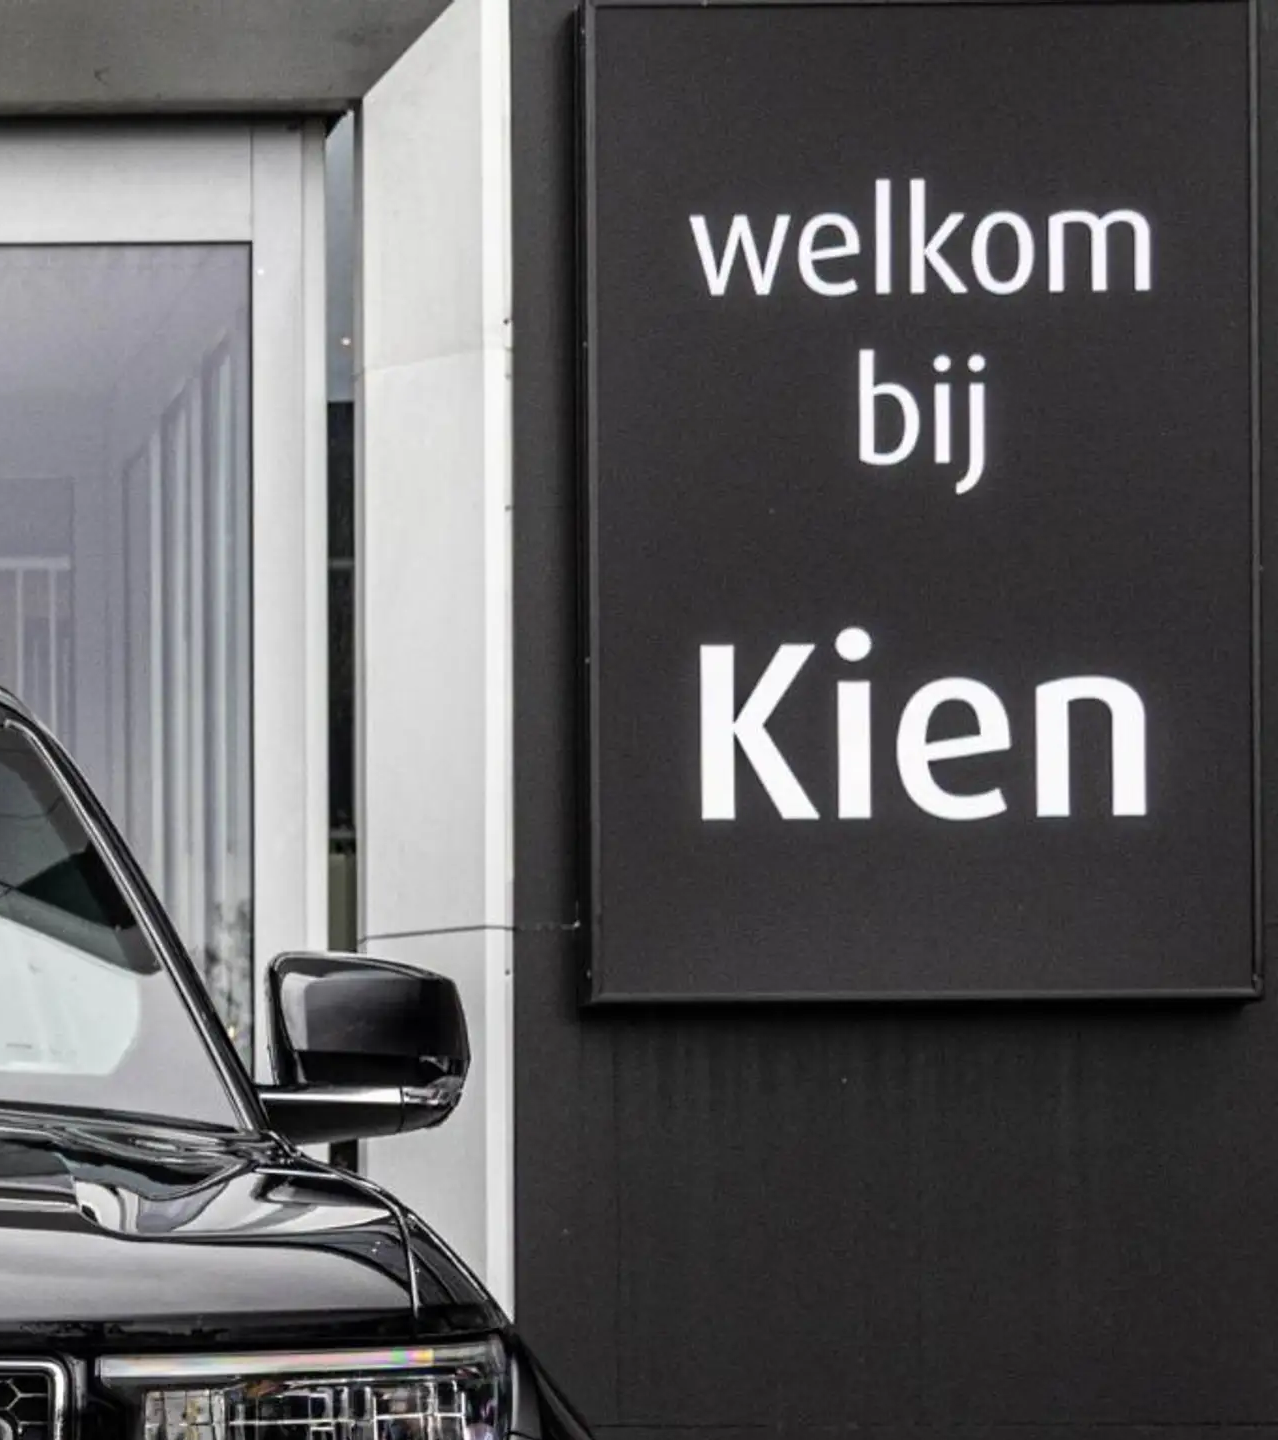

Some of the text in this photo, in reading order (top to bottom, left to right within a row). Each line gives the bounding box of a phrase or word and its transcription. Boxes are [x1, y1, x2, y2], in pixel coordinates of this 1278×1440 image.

[689, 178, 1152, 296] welkom
[858, 349, 986, 495] bij
[699, 627, 1147, 820] Kien
